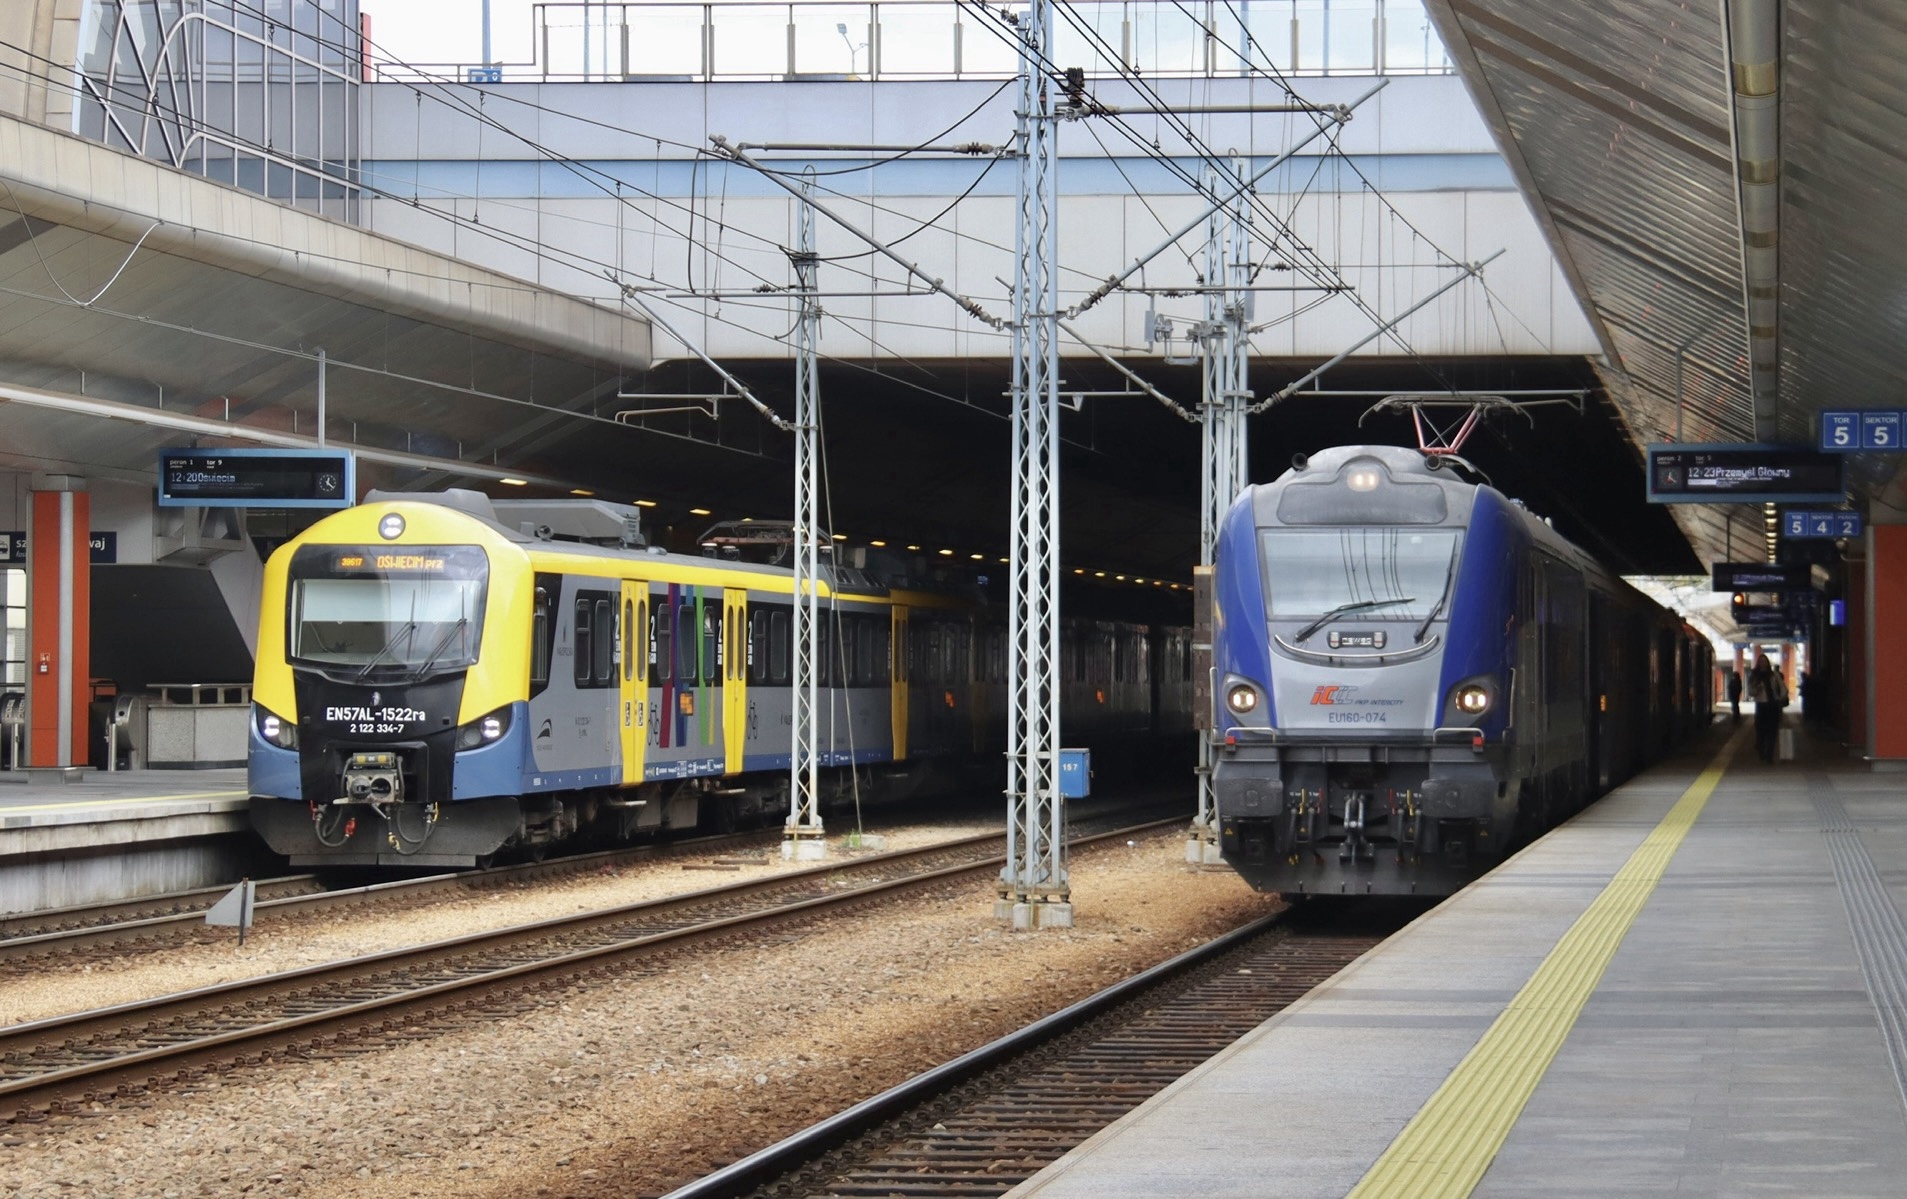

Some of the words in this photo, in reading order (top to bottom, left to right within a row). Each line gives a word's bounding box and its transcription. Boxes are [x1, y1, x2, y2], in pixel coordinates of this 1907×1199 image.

[1834, 426, 1849, 445] 5
[1874, 426, 1889, 445] 5
[1792, 521, 1802, 533] 5
[1817, 521, 1827, 533] 4
[1842, 521, 1852, 533] 2
[425, 559, 443, 569] prz
[650, 615, 655, 640] 2
[718, 619, 722, 642] 2
[748, 621, 752, 643] 2
[326, 707, 426, 721] EN57AL-1522ra
[1328, 712, 1386, 723] EU160-074
[350, 723, 356, 733] 2
[359, 723, 374, 733] 122
[376, 723, 404, 733] 334-7
